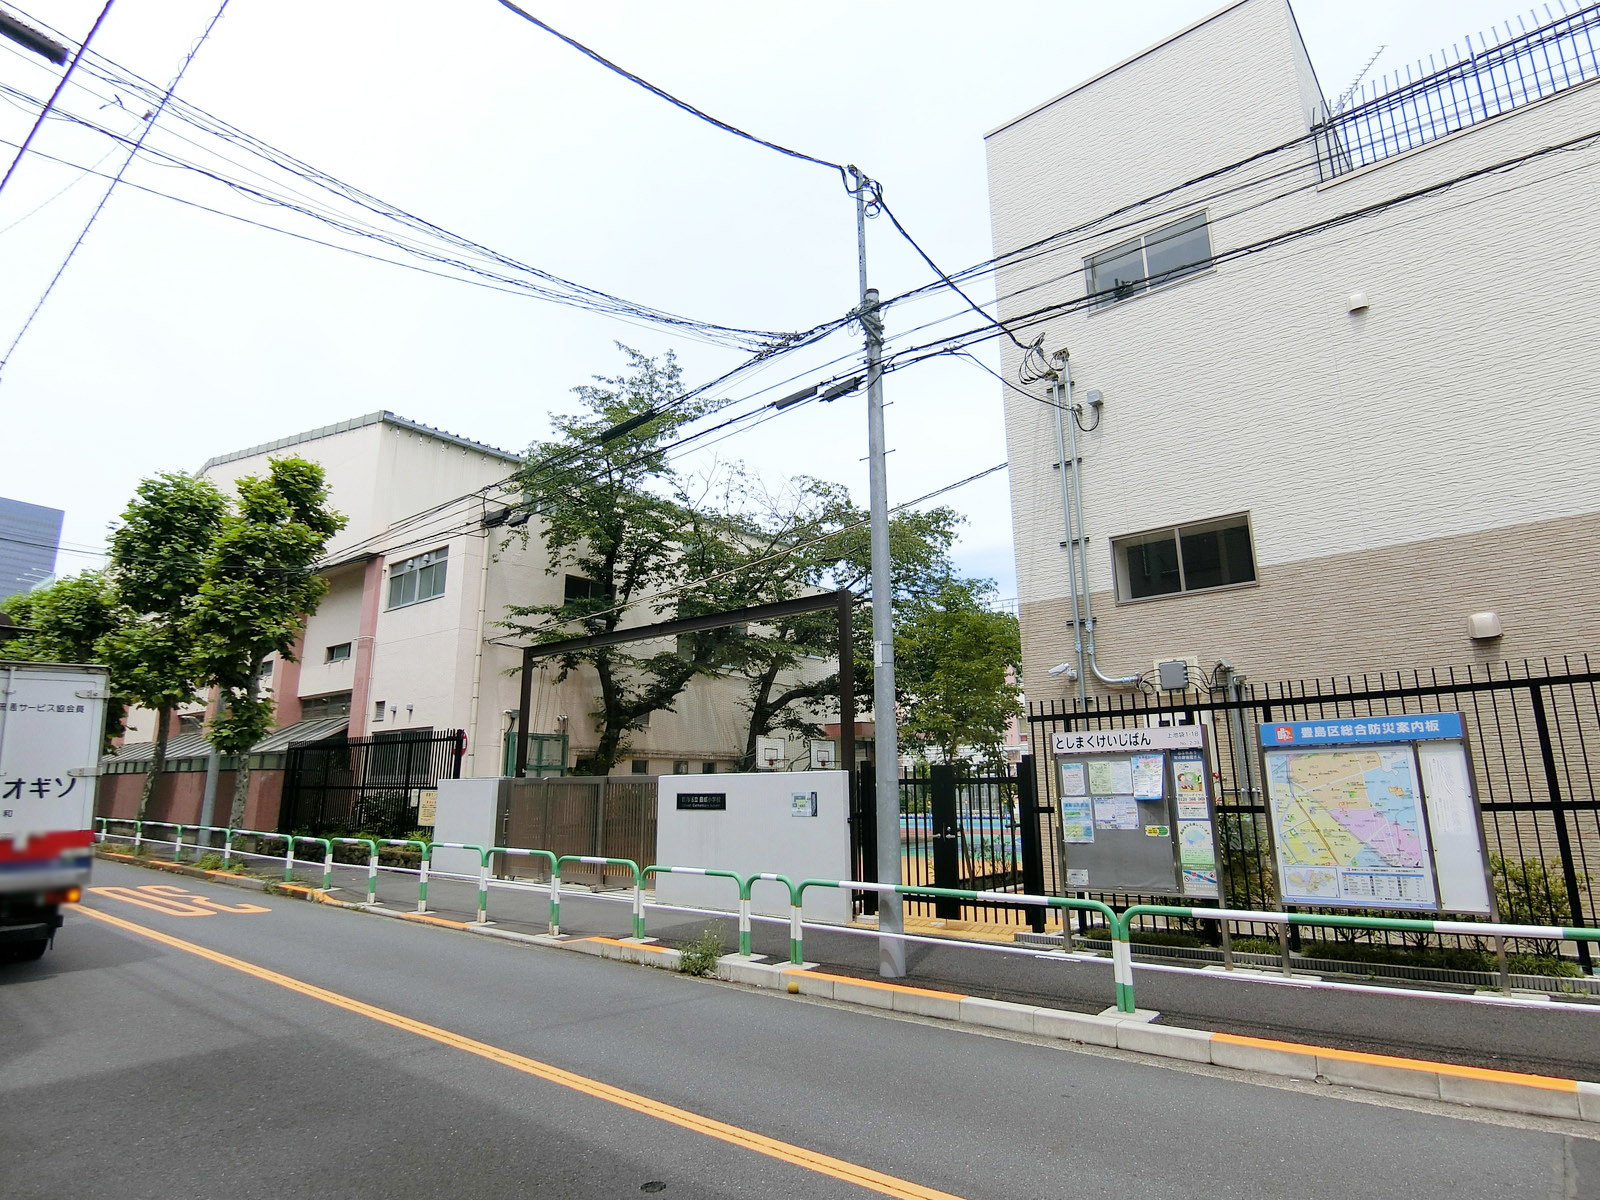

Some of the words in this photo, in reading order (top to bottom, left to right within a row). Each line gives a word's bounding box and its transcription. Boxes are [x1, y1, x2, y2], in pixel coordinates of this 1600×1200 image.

[1300, 720, 1440, 739] 豊島区総合防災案内板
[1055, 732, 1152, 750] としまくけいじばん
[2, 777, 77, 800] オギソ
